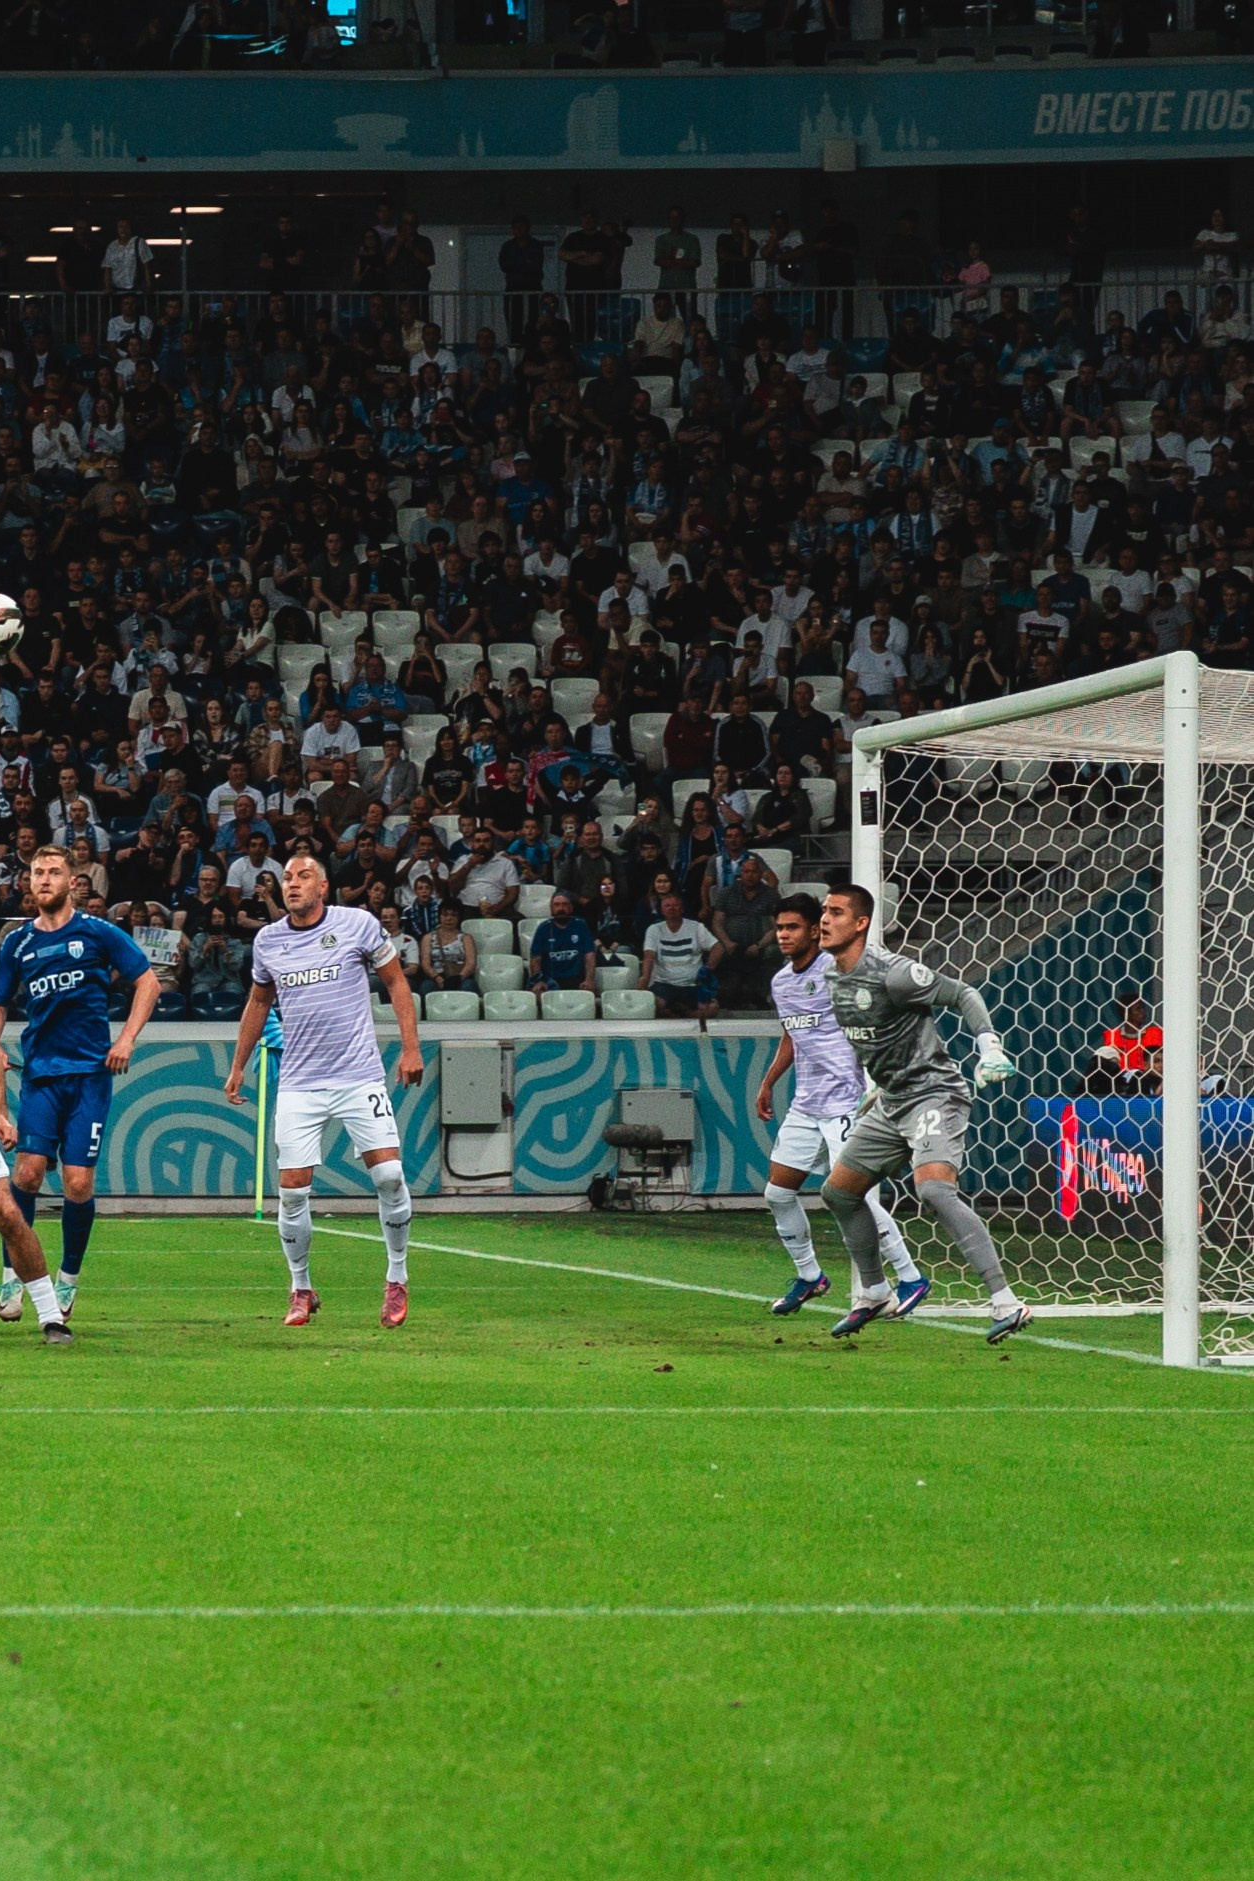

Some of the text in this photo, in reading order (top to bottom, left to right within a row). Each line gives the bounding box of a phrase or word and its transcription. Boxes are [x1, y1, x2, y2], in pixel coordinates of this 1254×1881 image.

[1033, 88, 1254, 135] ВМЕСТЕ ПОБ
[29, 970, 85, 996] РОТОР
[279, 964, 342, 989] FONBET
[89, 1122, 102, 1151] 5
[915, 1109, 942, 1140] 32
[1102, 1138, 1145, 1204] Видео
